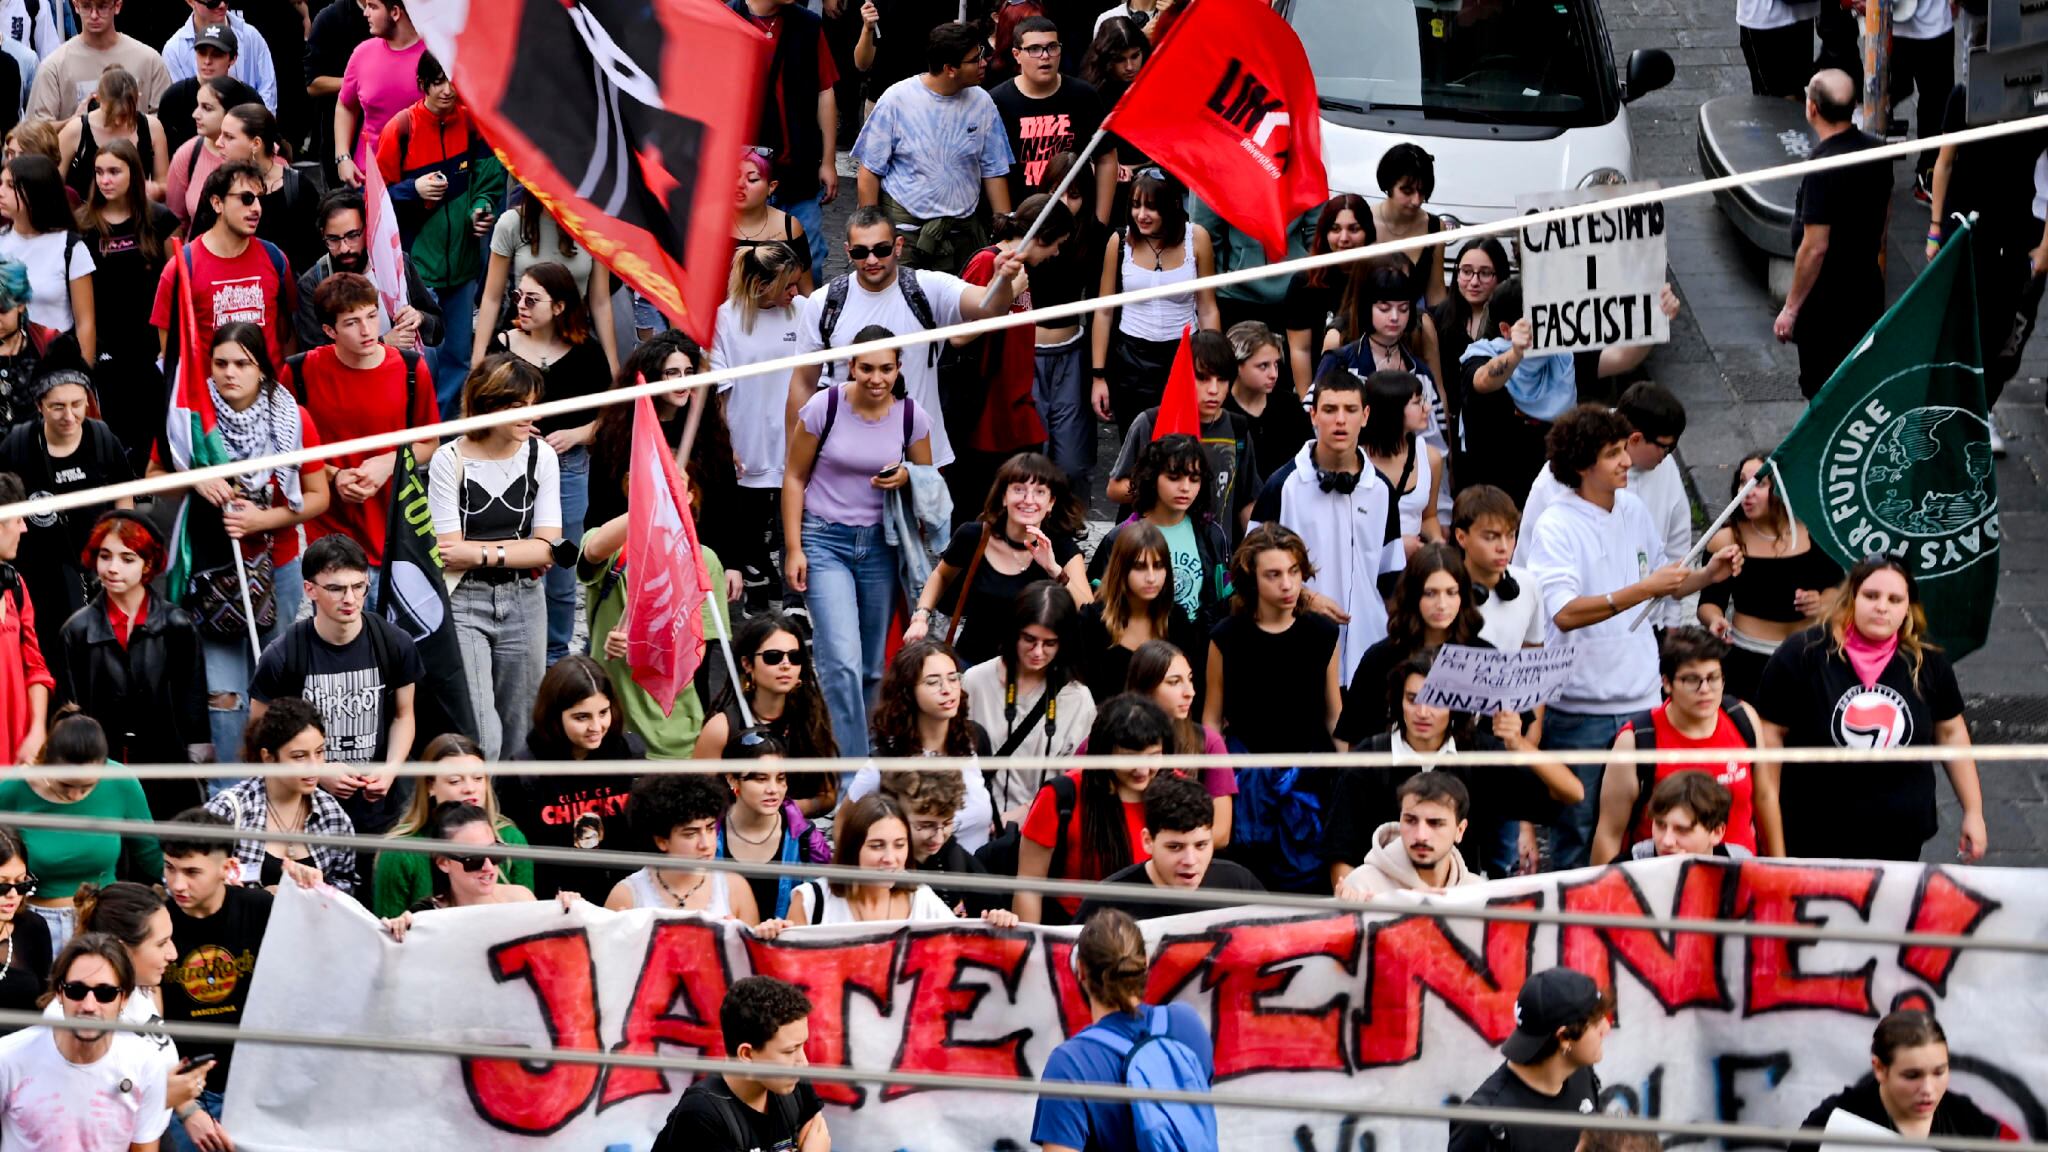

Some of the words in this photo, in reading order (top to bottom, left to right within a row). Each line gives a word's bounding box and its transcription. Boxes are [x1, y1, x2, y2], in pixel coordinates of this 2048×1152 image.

[1587, 255, 1596, 290] I
[1531, 294, 1652, 350] FASCISTI
[1829, 398, 1892, 524] FUTURE
[542, 793, 630, 825] CHUCKY
